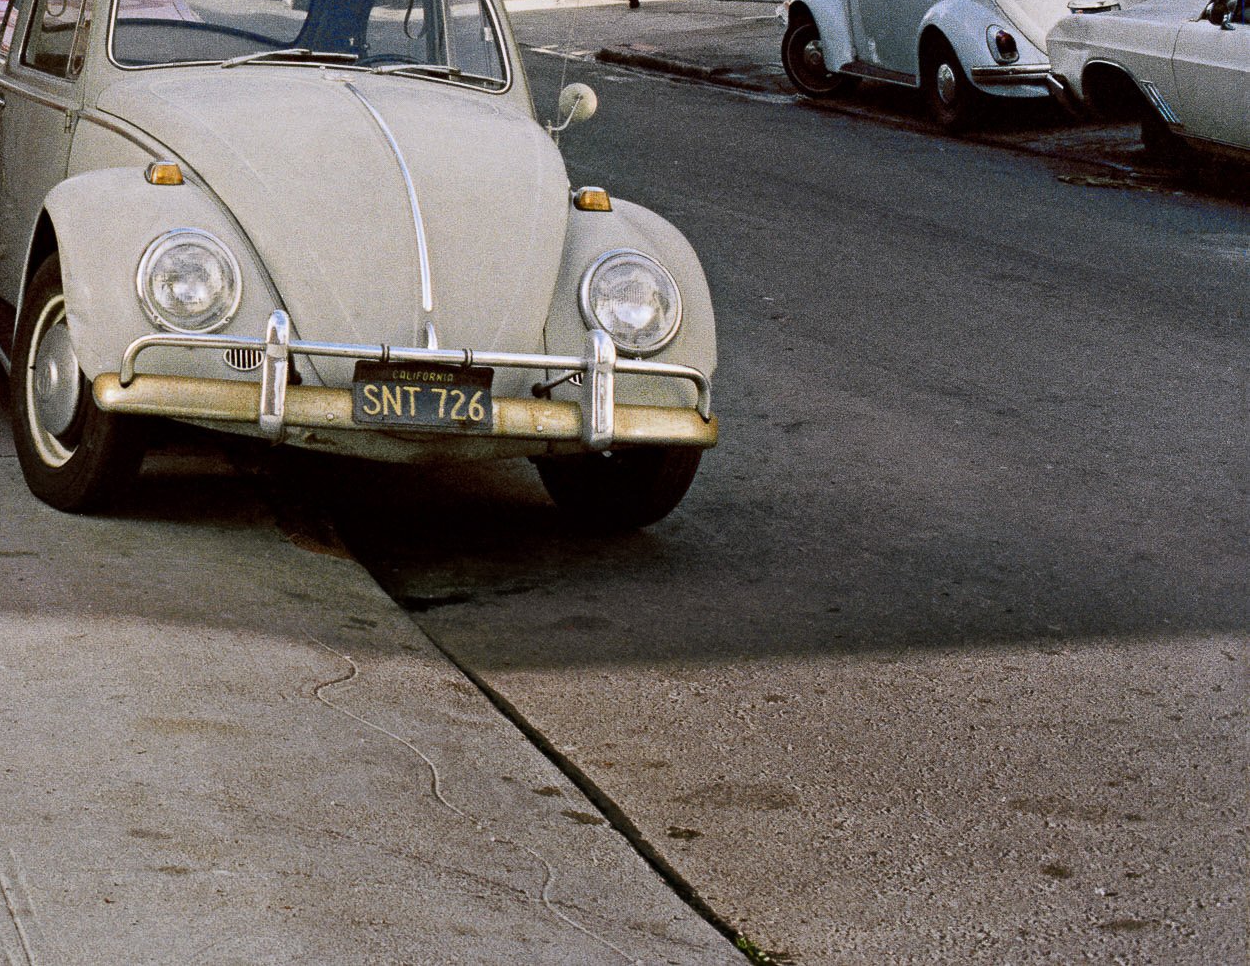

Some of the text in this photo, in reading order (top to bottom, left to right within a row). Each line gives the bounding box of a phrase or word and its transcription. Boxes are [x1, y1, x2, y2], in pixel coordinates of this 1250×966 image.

[392, 370, 454, 382] CALIFORNIA
[363, 384, 485, 421] SNT 726
